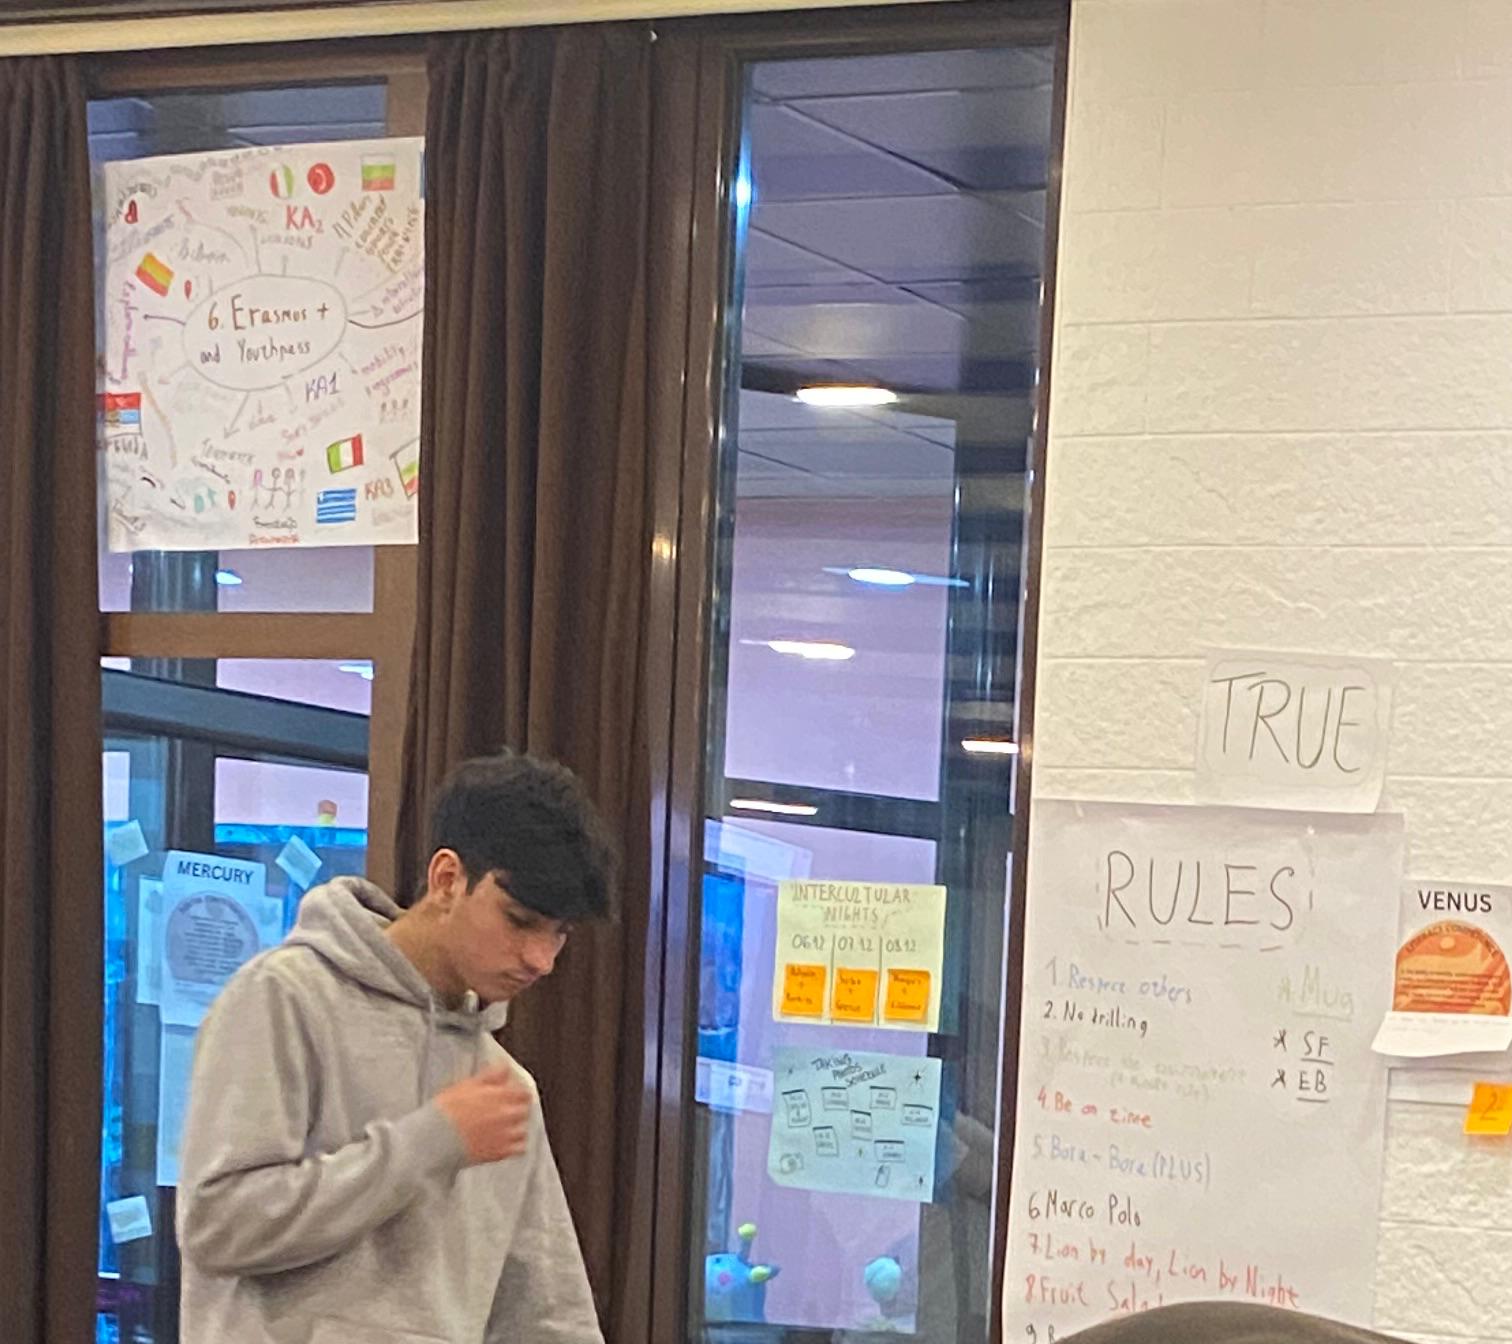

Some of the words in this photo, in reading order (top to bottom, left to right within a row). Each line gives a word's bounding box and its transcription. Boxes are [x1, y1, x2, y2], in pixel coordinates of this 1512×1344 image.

[231, 294, 307, 331] Erasmus
[317, 302, 329, 320] +
[200, 343, 221, 364] and
[305, 371, 340, 403] KA1
[364, 478, 394, 500] KA3
[1212, 672, 1369, 773] TRUE
[177, 860, 254, 885] MERCURY
[1106, 850, 1296, 932] RULES
[1418, 890, 1493, 912] VENUS
[824, 906, 880, 922] NIGHTS
[1068, 962, 1126, 994] Respect
[1139, 975, 1193, 1004] others
[1043, 1000, 1057, 1020] 2.
[1063, 1000, 1084, 1021] No
[1303, 1030, 1329, 1057] SF
[1299, 1068, 1327, 1093] EB
[1054, 1091, 1073, 1112] Be
[1081, 1104, 1098, 1115] on
[1110, 1107, 1152, 1129] time
[1151, 1151, 1211, 1191] (PLUS)
[1046, 1189, 1095, 1219] Marco
[1108, 1193, 1142, 1227] Polo
[1045, 1233, 1078, 1260] Lion
[1089, 1237, 1106, 1266] by
[1168, 1250, 1206, 1281] Lion
[1219, 1260, 1238, 1291] by
[1246, 1265, 1301, 1309] Night
[1041, 1277, 1089, 1307] Fruit
